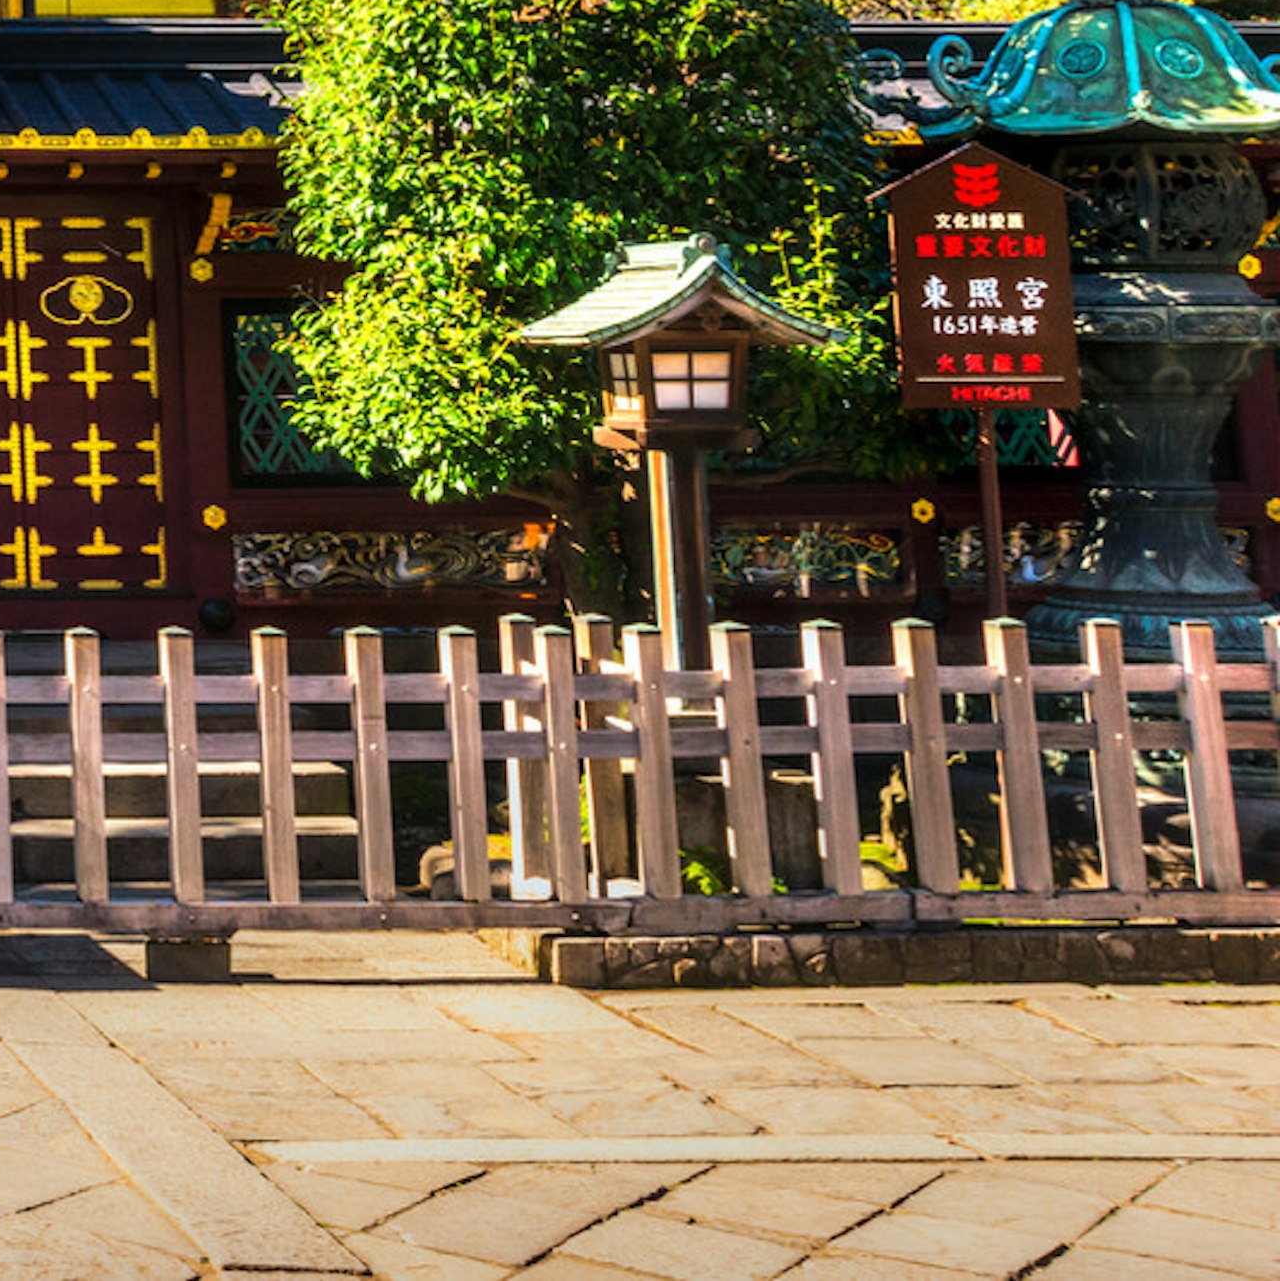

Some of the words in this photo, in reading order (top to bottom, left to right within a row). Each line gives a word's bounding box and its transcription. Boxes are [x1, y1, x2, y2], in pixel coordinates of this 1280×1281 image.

[916, 235, 1045, 257] 重要文化財
[922, 275, 1048, 310] 東照宮
[934, 315, 1038, 336] 1651年造営
[952, 386, 1030, 400] HITACHI
